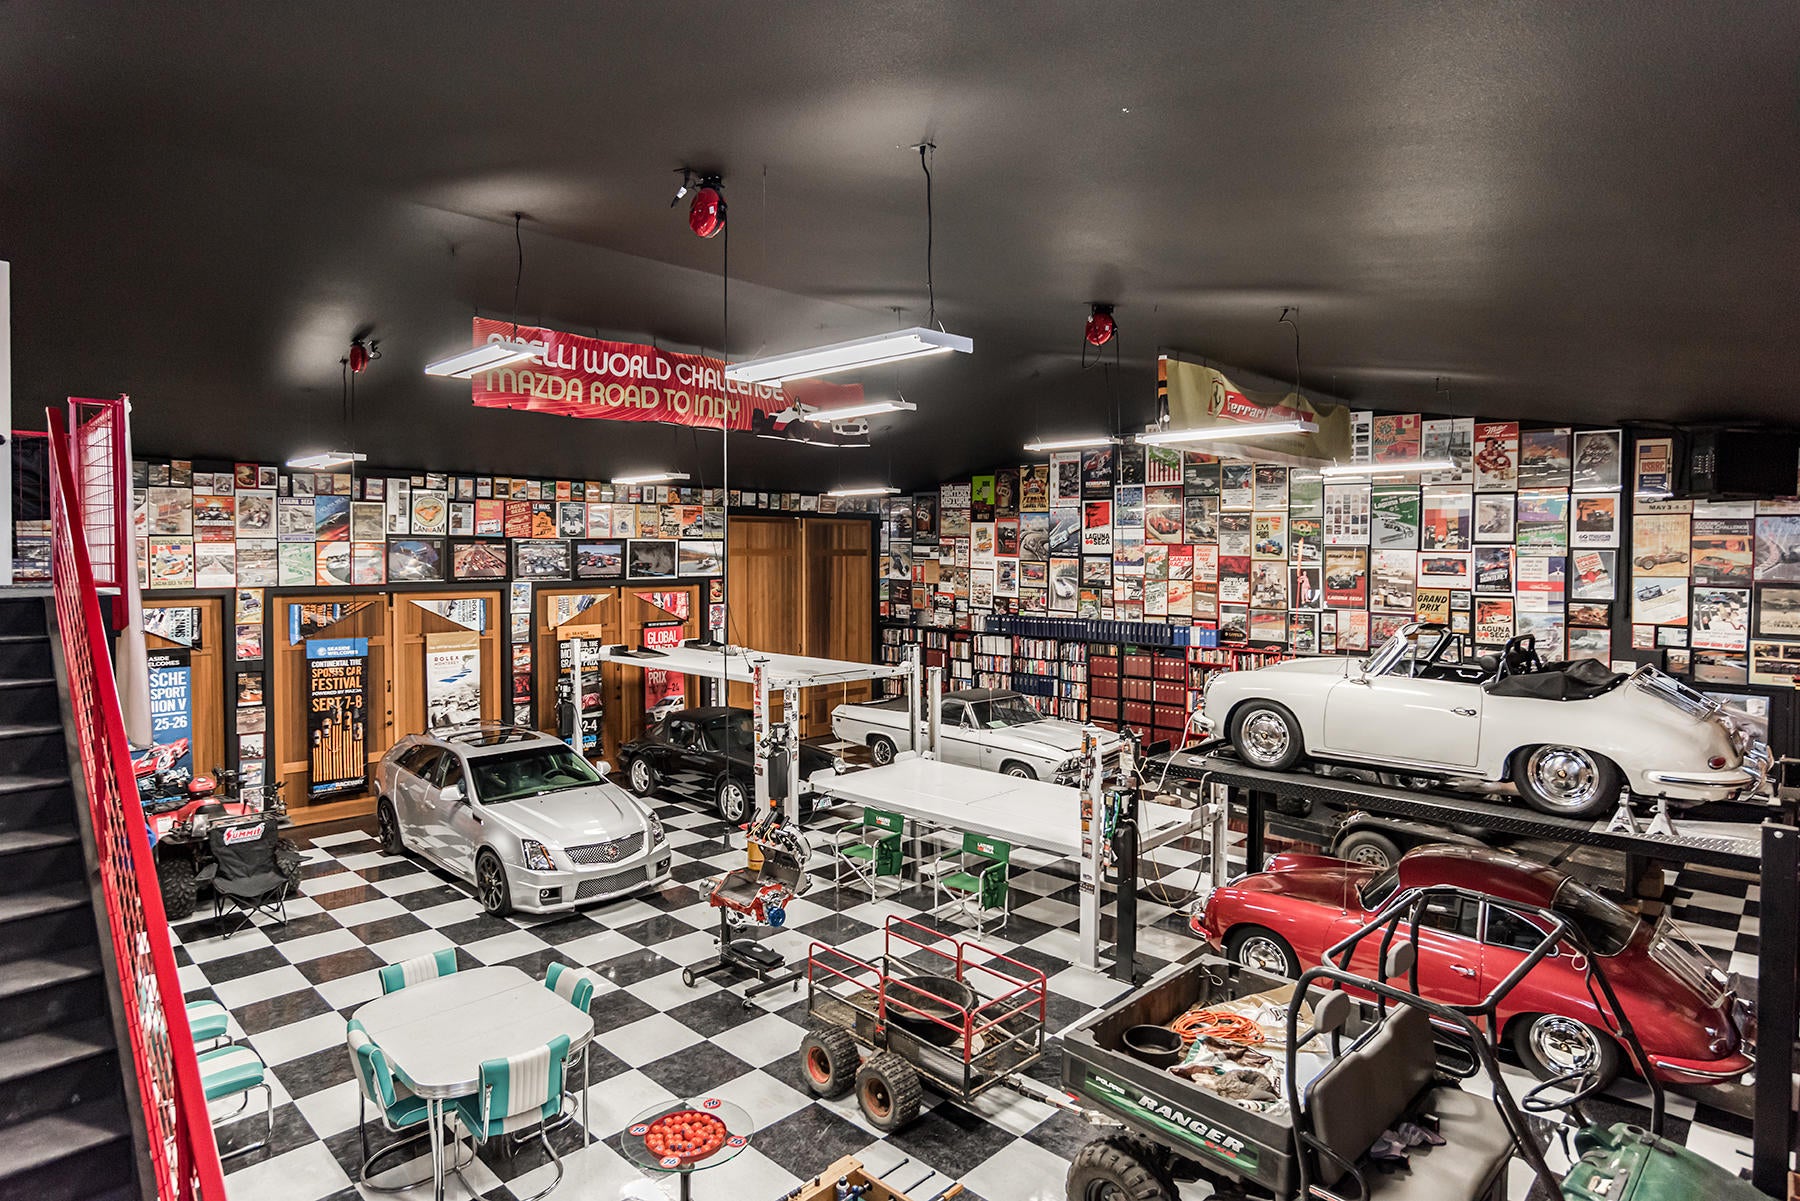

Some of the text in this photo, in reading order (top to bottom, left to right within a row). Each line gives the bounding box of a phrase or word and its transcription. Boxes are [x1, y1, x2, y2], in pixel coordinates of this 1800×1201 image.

[583, 349, 671, 381] WORLD
[486, 368, 740, 421] MAZDA ROAD TO INDY
[1226, 395, 1266, 420] Ferrari
[1417, 594, 1448, 604] GRAND
[1419, 603, 1441, 612] PRIX
[1476, 625, 1511, 633] LAGUNA
[1490, 631, 1511, 639] SECA
[647, 630, 679, 645] GLOBAL
[311, 658, 362, 668] CONTINENTAL TIRE
[312, 666, 362, 678] SPORTS CAR
[648, 670, 667, 685] PRIX
[149, 671, 187, 688] SCHE
[312, 676, 363, 692] FESTIVAL
[151, 685, 187, 701] SPORT
[177, 697, 187, 711] V
[312, 694, 363, 713] SEPT 7-8
[154, 715, 188, 731] 25-26
[582, 719, 598, 732] 2-4
[336, 779, 365, 787] RACEWAY
[706, 1099, 718, 1107] 76
[1137, 1095, 1245, 1153] RANGER
[730, 1137, 743, 1145] 76
